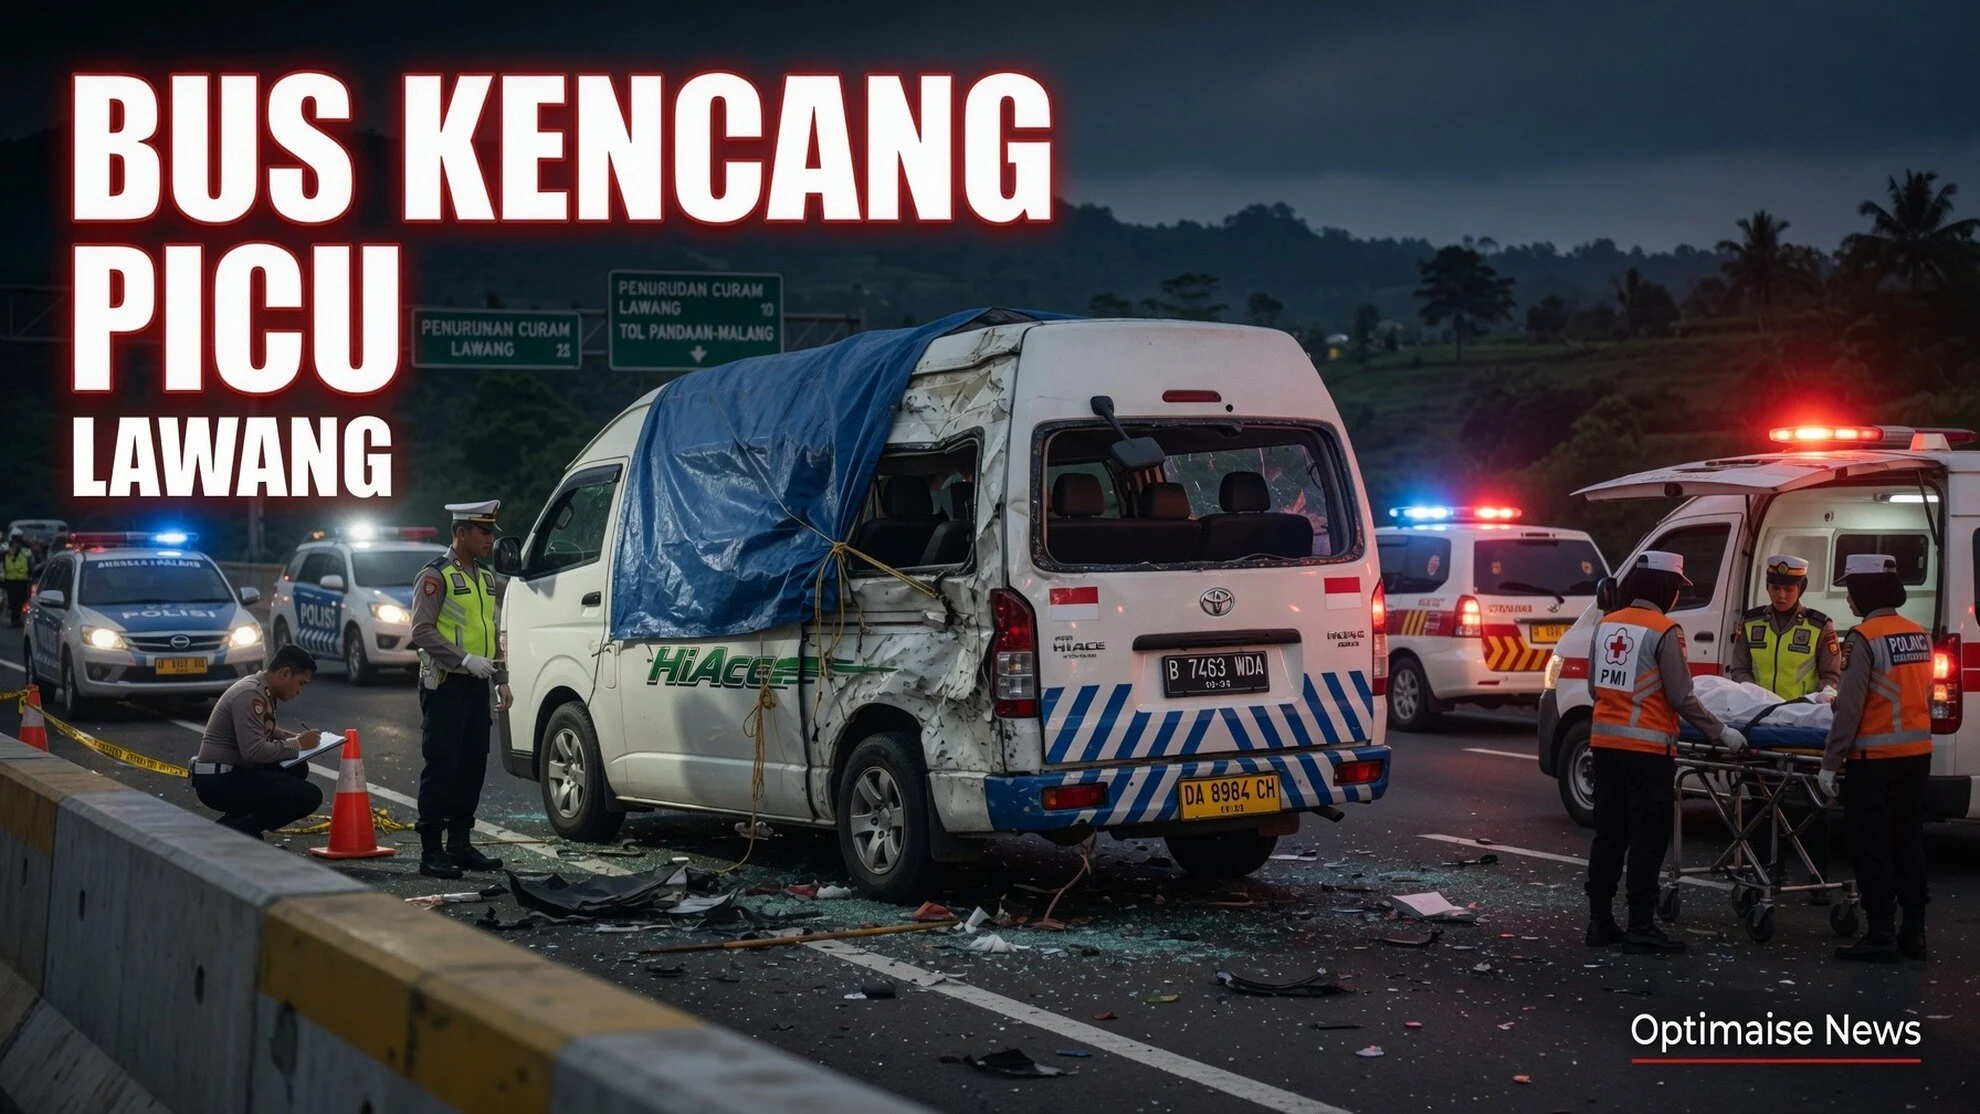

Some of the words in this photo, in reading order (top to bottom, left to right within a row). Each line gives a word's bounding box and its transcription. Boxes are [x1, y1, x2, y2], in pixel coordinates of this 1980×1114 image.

[712, 283, 764, 298] CURAM
[619, 300, 682, 315] LAWANG
[760, 303, 774, 316] 10
[421, 319, 513, 336] PENURUNAN
[518, 321, 571, 337] CURAM
[619, 323, 645, 340] TOL
[650, 324, 774, 341] PANDAAN-MALANG
[451, 341, 515, 357] LAWANG
[1053, 641, 1106, 652] HIACE
[1169, 660, 1179, 680] B
[1188, 657, 1226, 679] 7463
[1234, 655, 1264, 676] WDA
[1600, 669, 1626, 686] PMI
[1184, 784, 1204, 805] DA
[1211, 780, 1250, 802] 8984
[1256, 778, 1275, 799] CH
